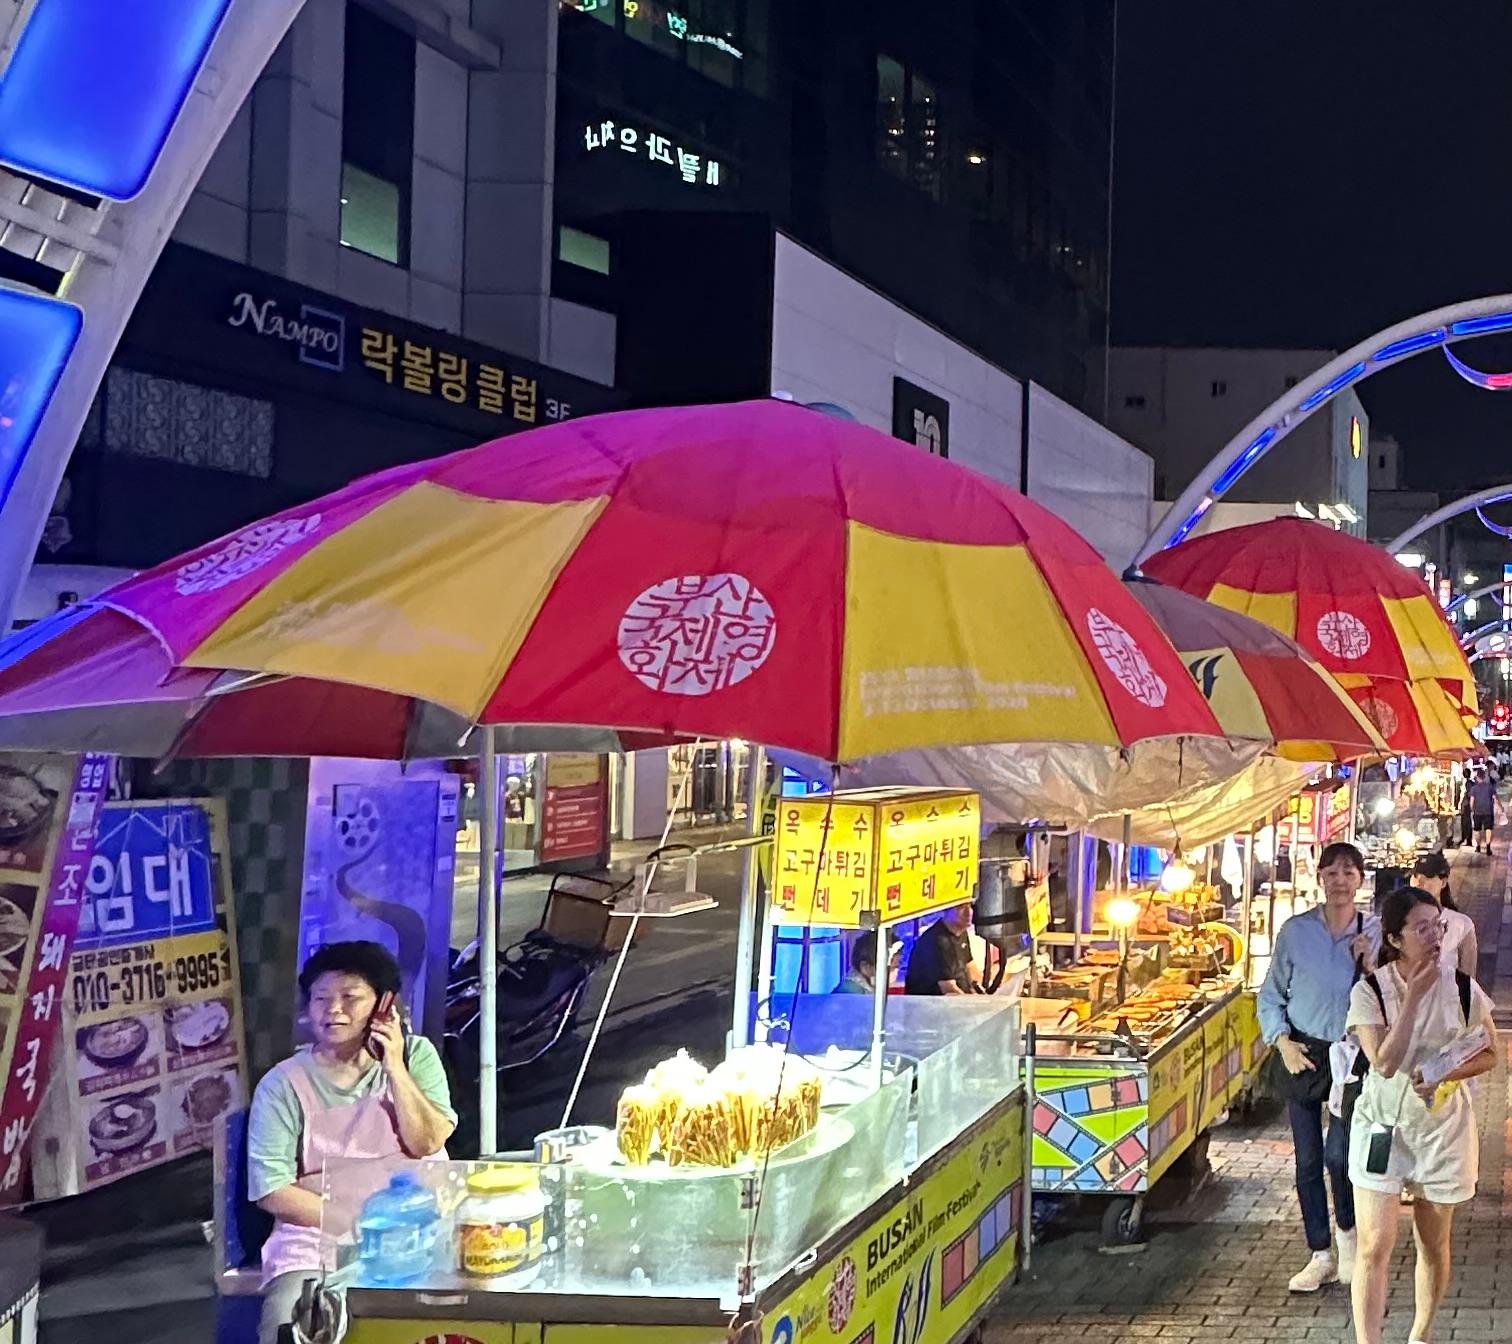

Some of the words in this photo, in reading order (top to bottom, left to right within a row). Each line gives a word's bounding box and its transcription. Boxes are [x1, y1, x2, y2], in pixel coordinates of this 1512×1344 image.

[783, 847, 868, 879] 고구마튀김
[886, 835, 971, 874] 고구마튀김
[84, 842, 195, 933] 임대
[866, 1198, 924, 1273] BUSAN
